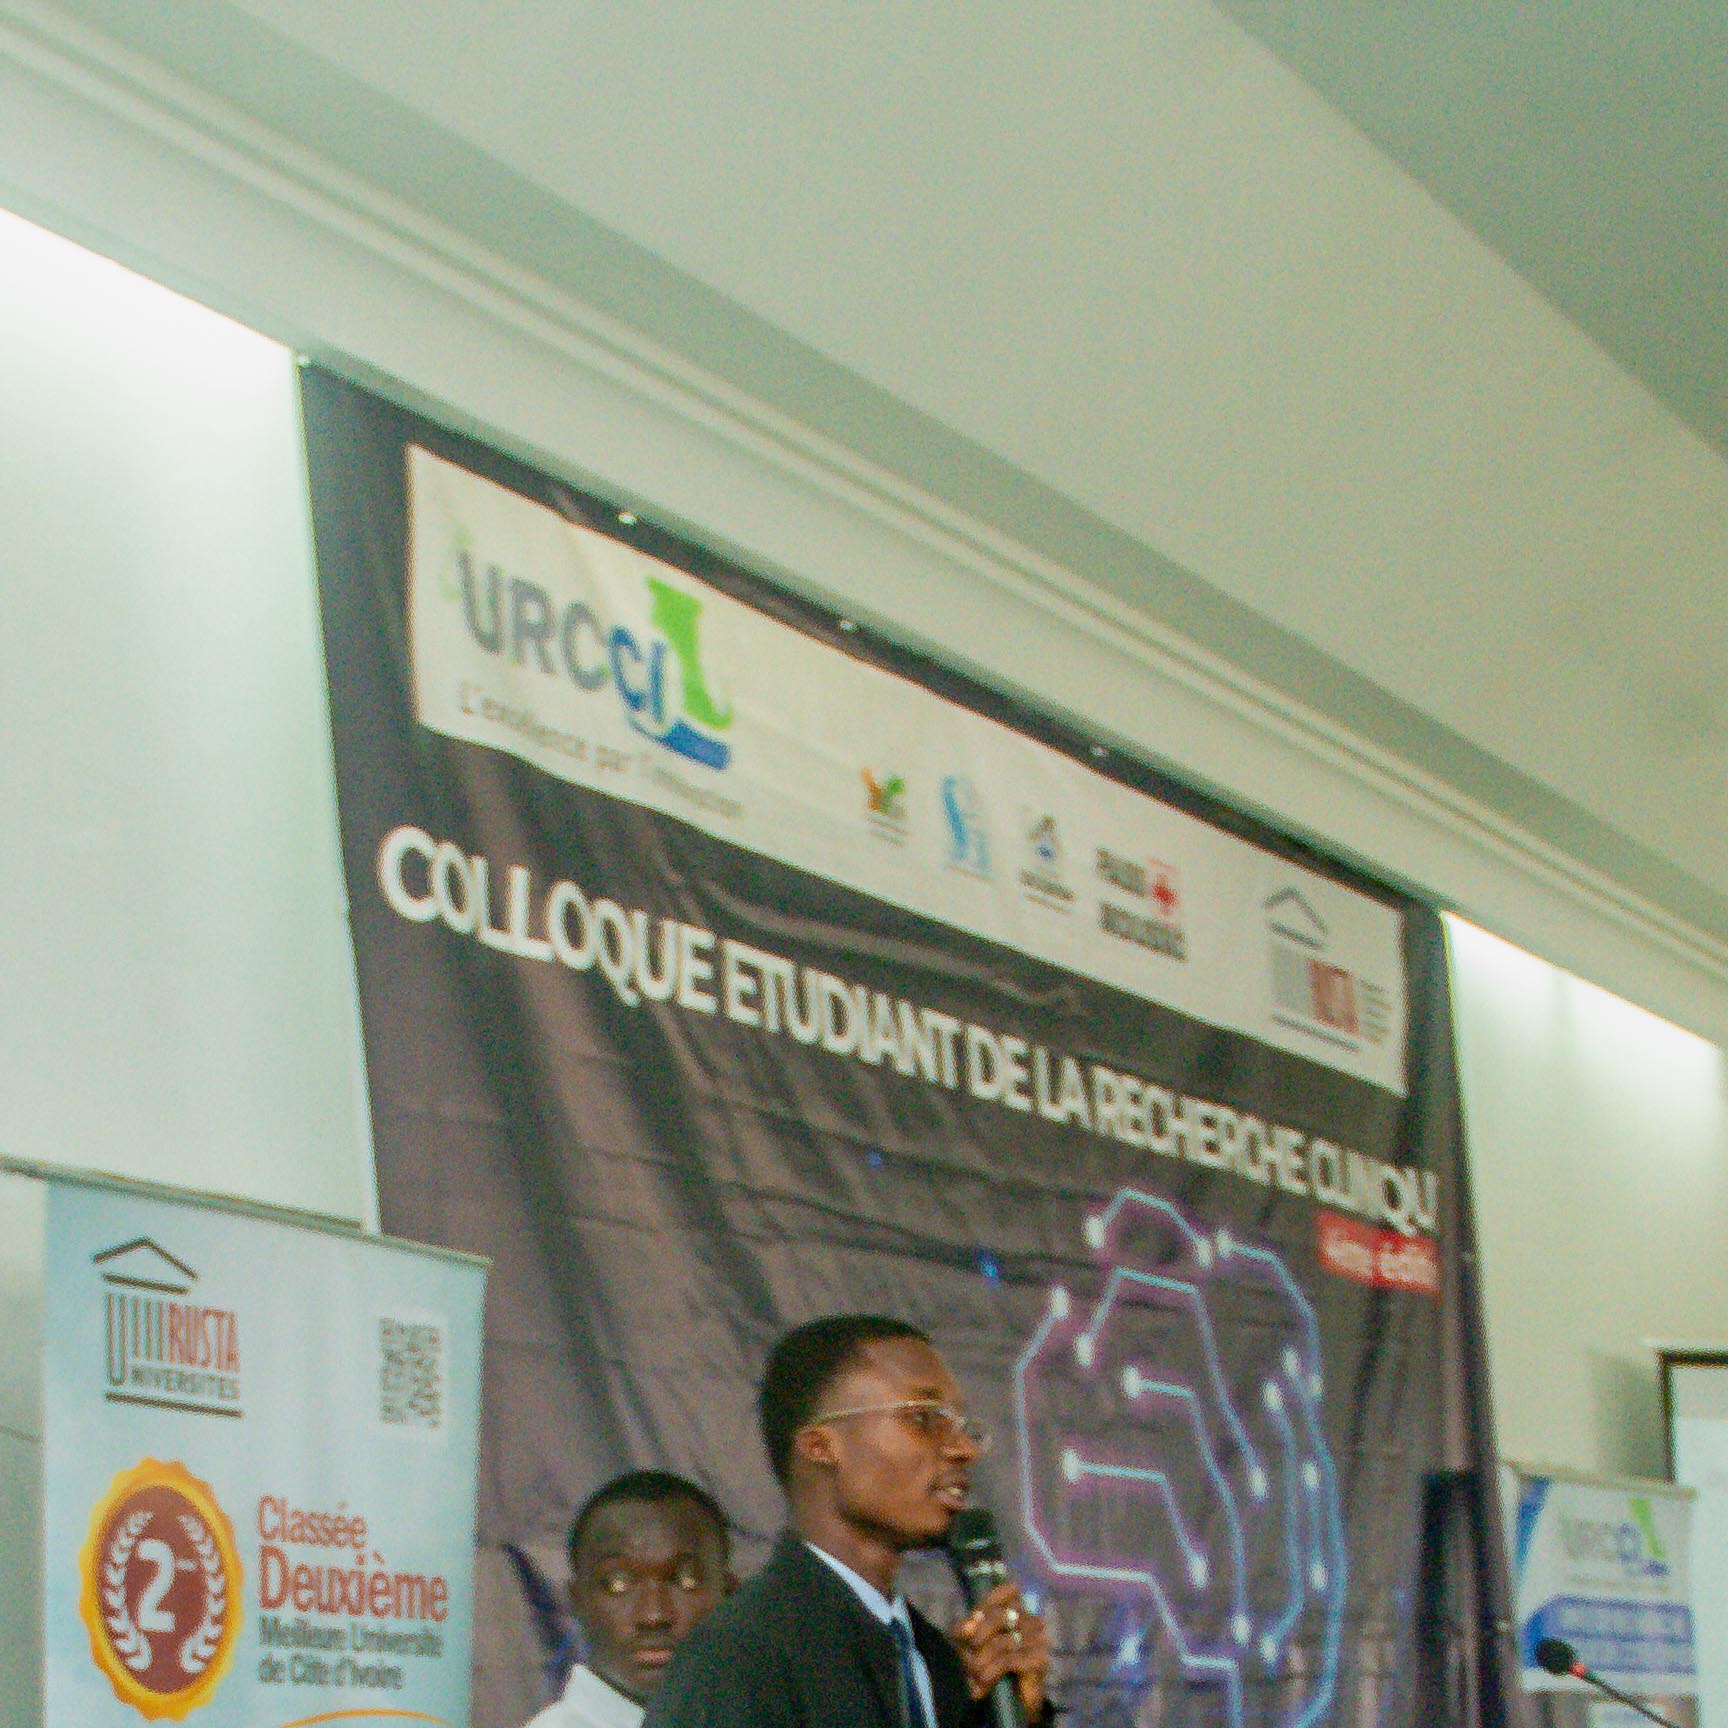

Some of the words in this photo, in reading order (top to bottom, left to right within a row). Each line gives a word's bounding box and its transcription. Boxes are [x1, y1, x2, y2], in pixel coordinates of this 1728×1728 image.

[379, 824, 716, 1016] COLLOQUE
[724, 937, 959, 1089] ETUDIANT
[970, 1019, 1029, 1112] DE
[1036, 1043, 1092, 1129] LA
[1093, 1063, 1308, 1197] RECHERCHE
[170, 1301, 239, 1373] RUSTA
[257, 1495, 367, 1549] Classée
[257, 1544, 448, 1622] Deuxième
[259, 1656, 284, 1687] de
[289, 1653, 328, 1687] Côte
